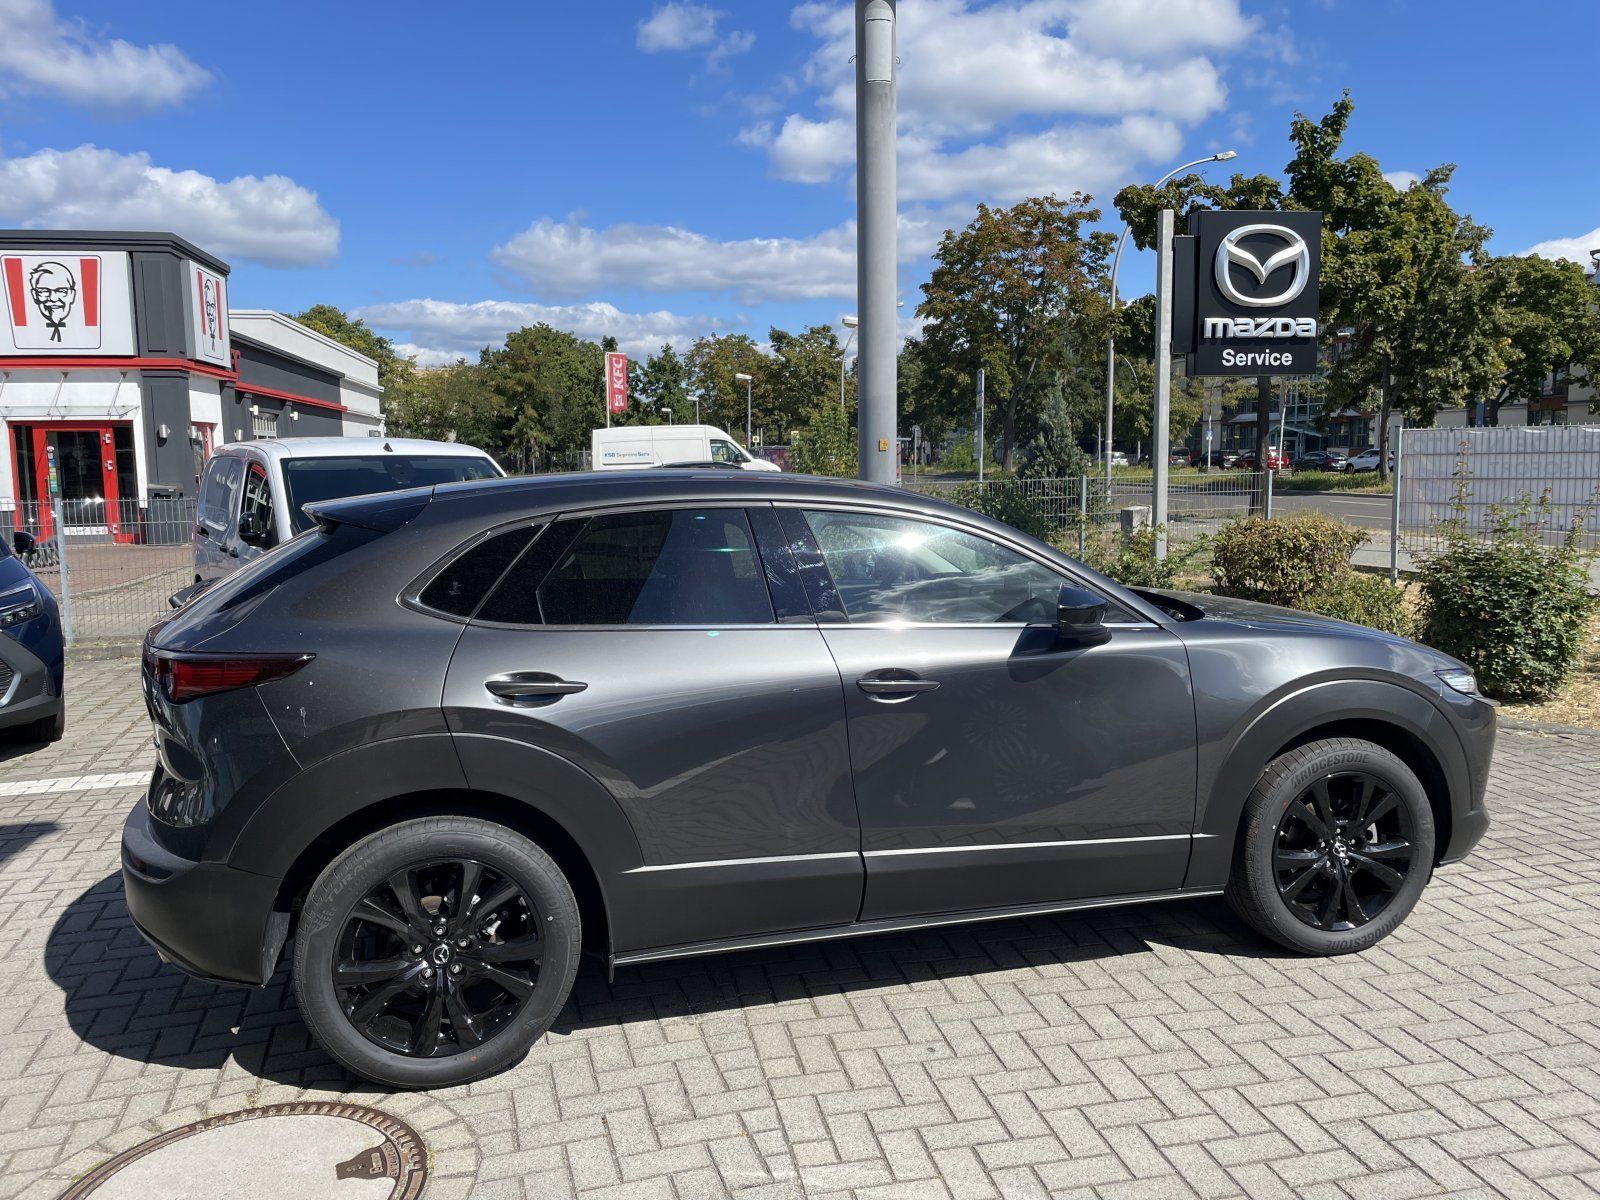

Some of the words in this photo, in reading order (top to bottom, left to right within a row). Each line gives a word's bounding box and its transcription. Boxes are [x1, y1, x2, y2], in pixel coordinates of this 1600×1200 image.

[1203, 317, 1317, 338] mazda
[1221, 349, 1293, 366] Service
[612, 358, 624, 390] KFC
[1290, 753, 1370, 789] BRIDGESTONE
[1326, 912, 1402, 951] BRIDGESTONE
